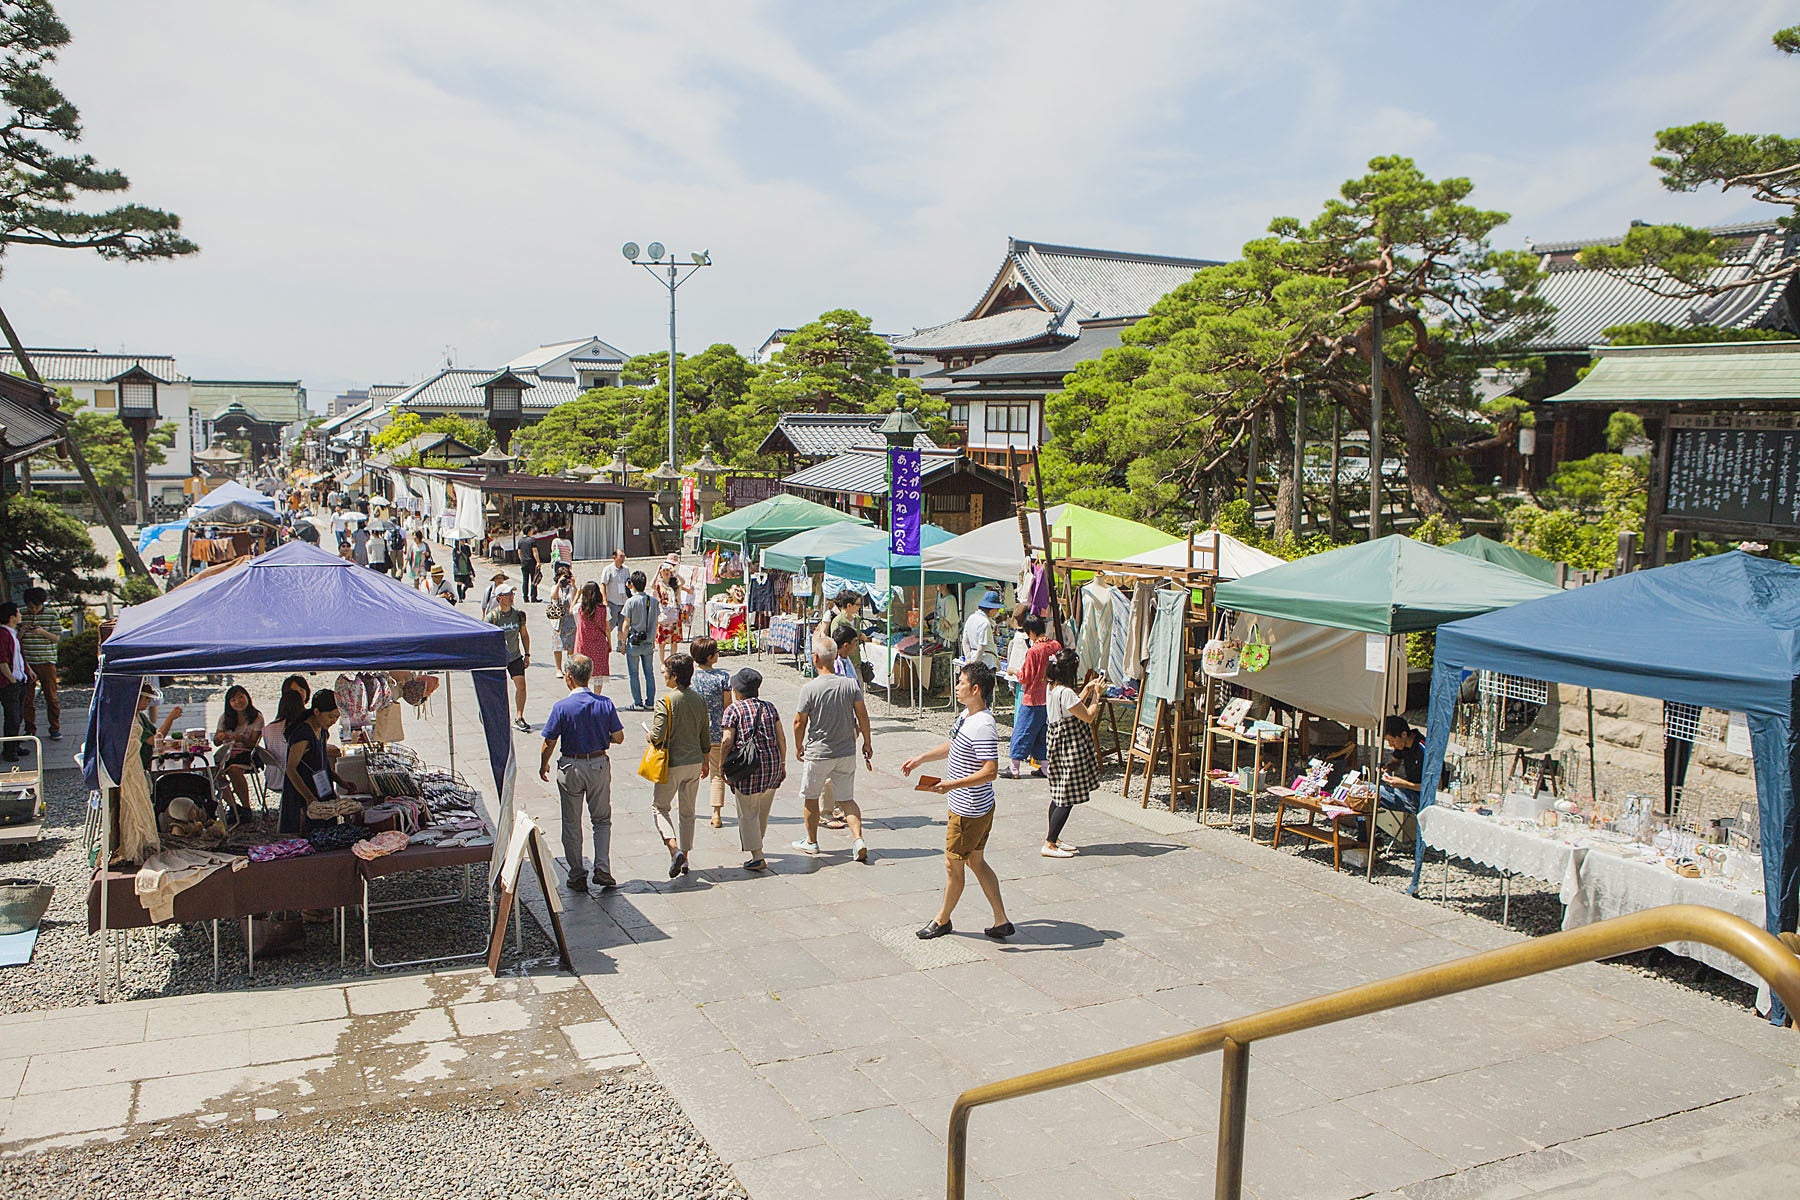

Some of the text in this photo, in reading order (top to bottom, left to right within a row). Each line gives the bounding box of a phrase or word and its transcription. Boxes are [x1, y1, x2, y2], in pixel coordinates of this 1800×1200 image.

[894, 454, 909, 553] あったかねこの会
